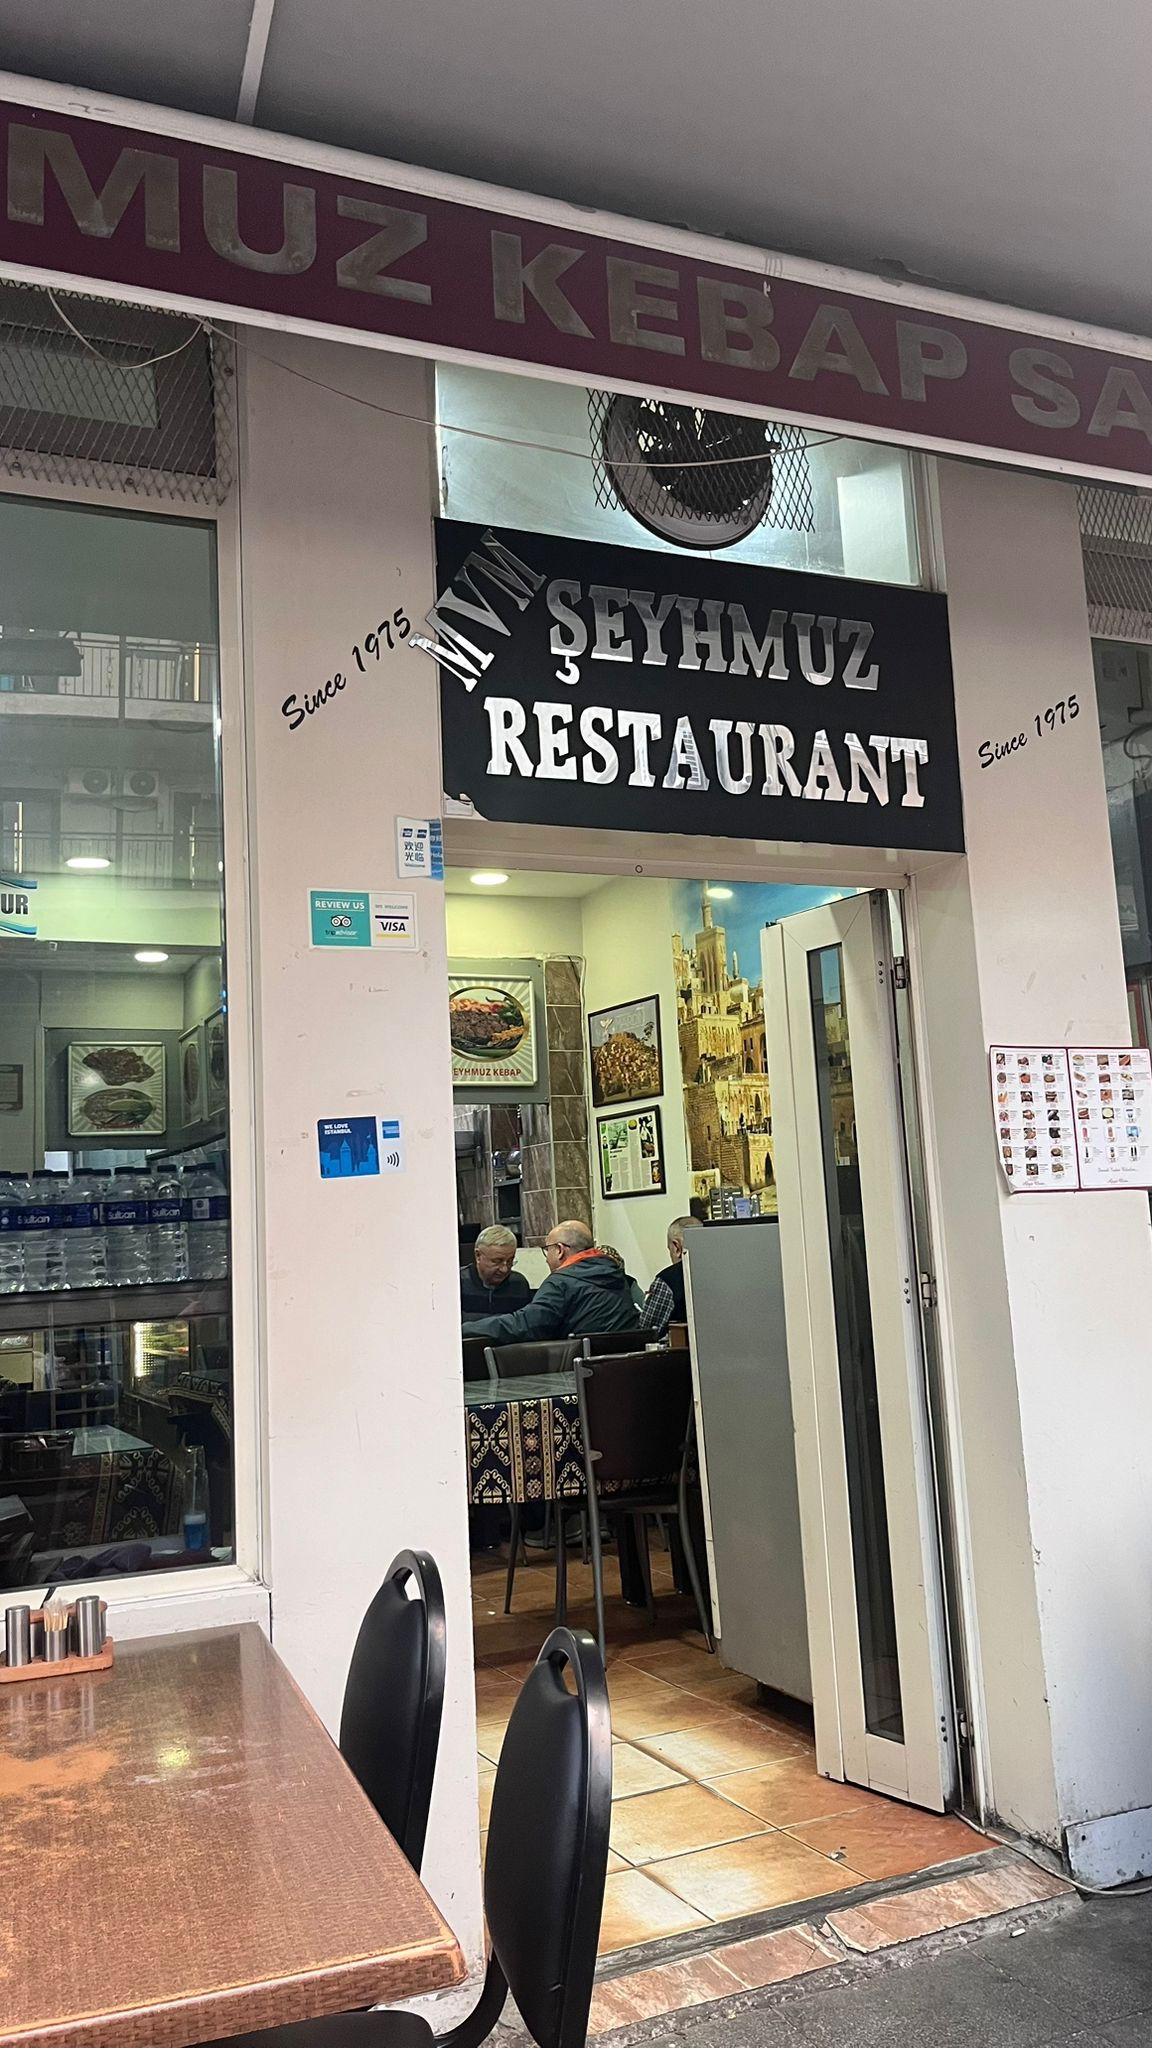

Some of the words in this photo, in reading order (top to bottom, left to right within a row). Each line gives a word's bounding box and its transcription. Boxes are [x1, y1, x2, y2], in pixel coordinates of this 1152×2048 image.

[7, 122, 432, 306] MUZ
[490, 229, 968, 402] KEBAP
[545, 577, 880, 692] ŞEYHMUZ
[281, 673, 348, 732] Since
[351, 606, 412, 673] 1975
[978, 732, 1028, 769] Since
[1034, 694, 1080, 738] 1975
[482, 696, 930, 809] RESTAURANT
[404, 841, 424, 852] 欢迎
[405, 851, 425, 862] 光临
[1, 893, 29, 915] UR
[315, 900, 350, 909] REVIEW
[353, 902, 365, 910] US
[380, 921, 406, 932] VISA
[493, 1068, 521, 1077] KEBAP
[152, 1207, 181, 1217] Sultan
